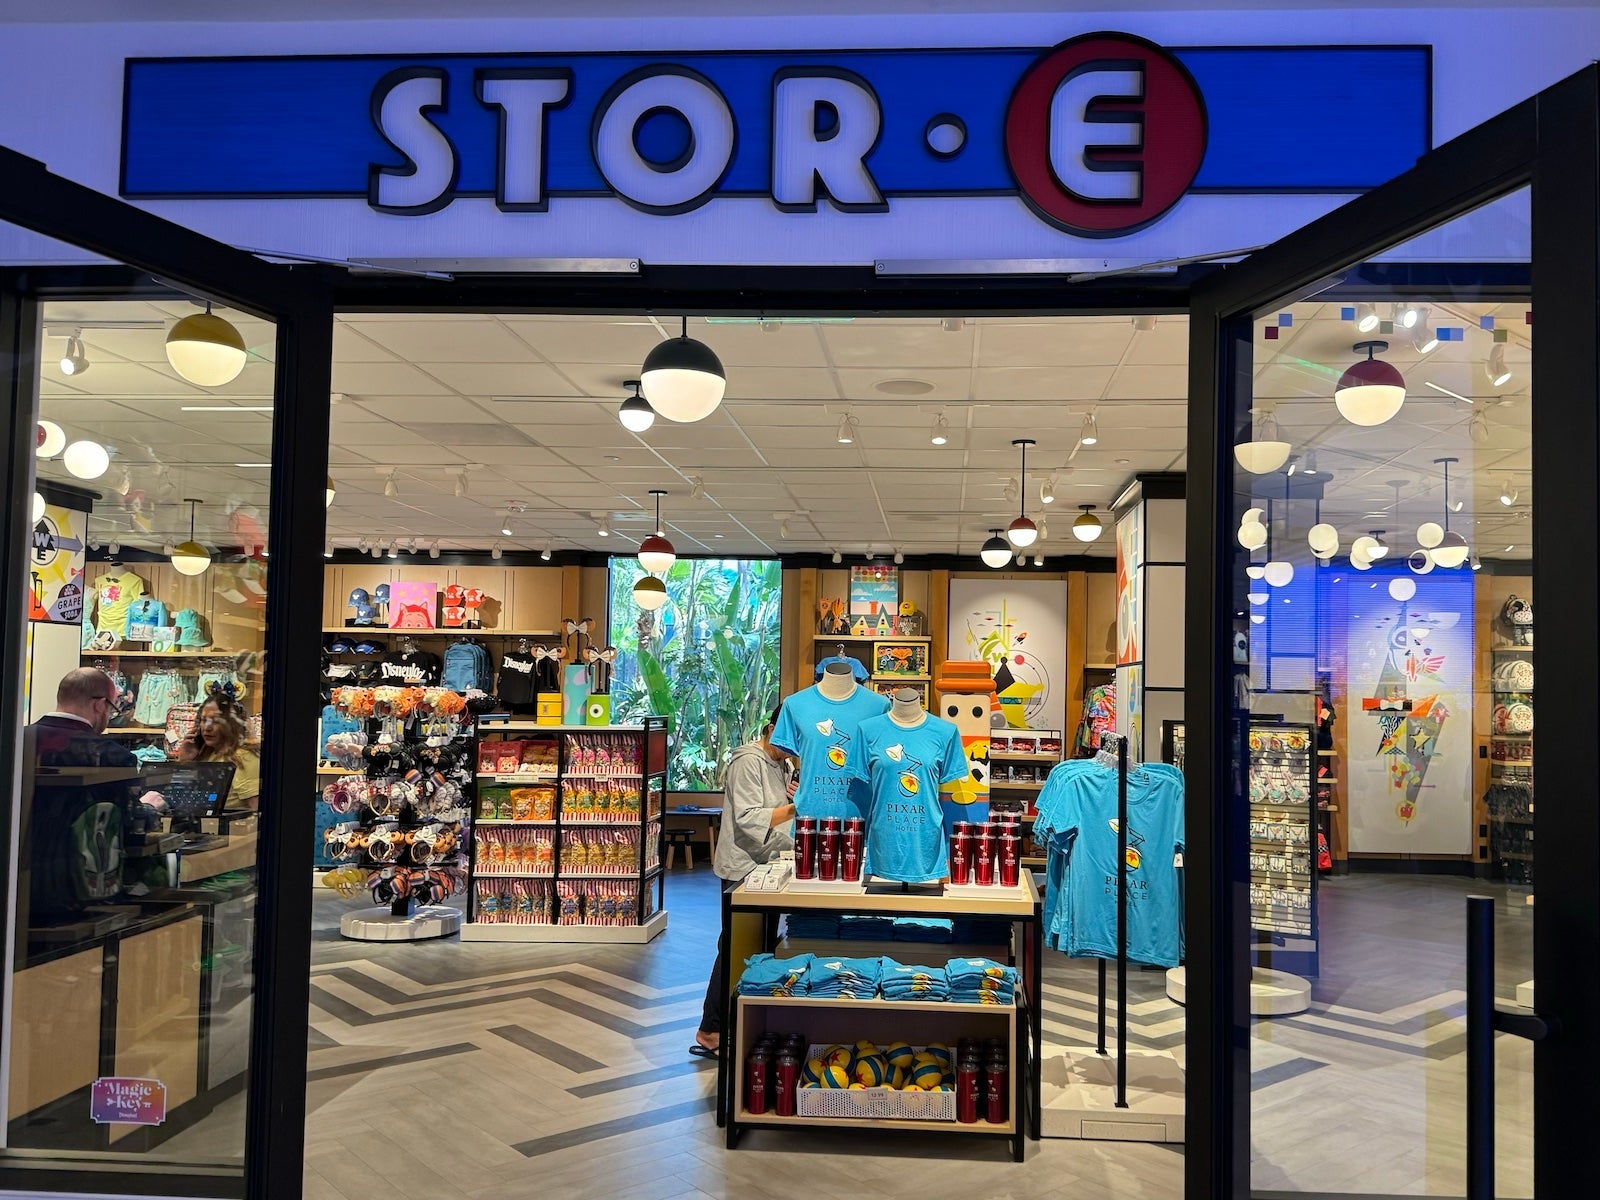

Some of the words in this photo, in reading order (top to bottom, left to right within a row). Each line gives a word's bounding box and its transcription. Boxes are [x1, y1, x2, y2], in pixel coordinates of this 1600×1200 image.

[57, 597, 81, 609] GRAPE
[64, 609, 78, 620] SODA
[814, 776, 853, 786] PIXAR
[814, 787, 853, 796] PLACE
[887, 803, 926, 815] PIXAR
[887, 815, 926, 824] PLACE
[1105, 875, 1148, 890] PIAR
[105, 1082, 152, 1098] Magic
[116, 1095, 142, 1112] Key
